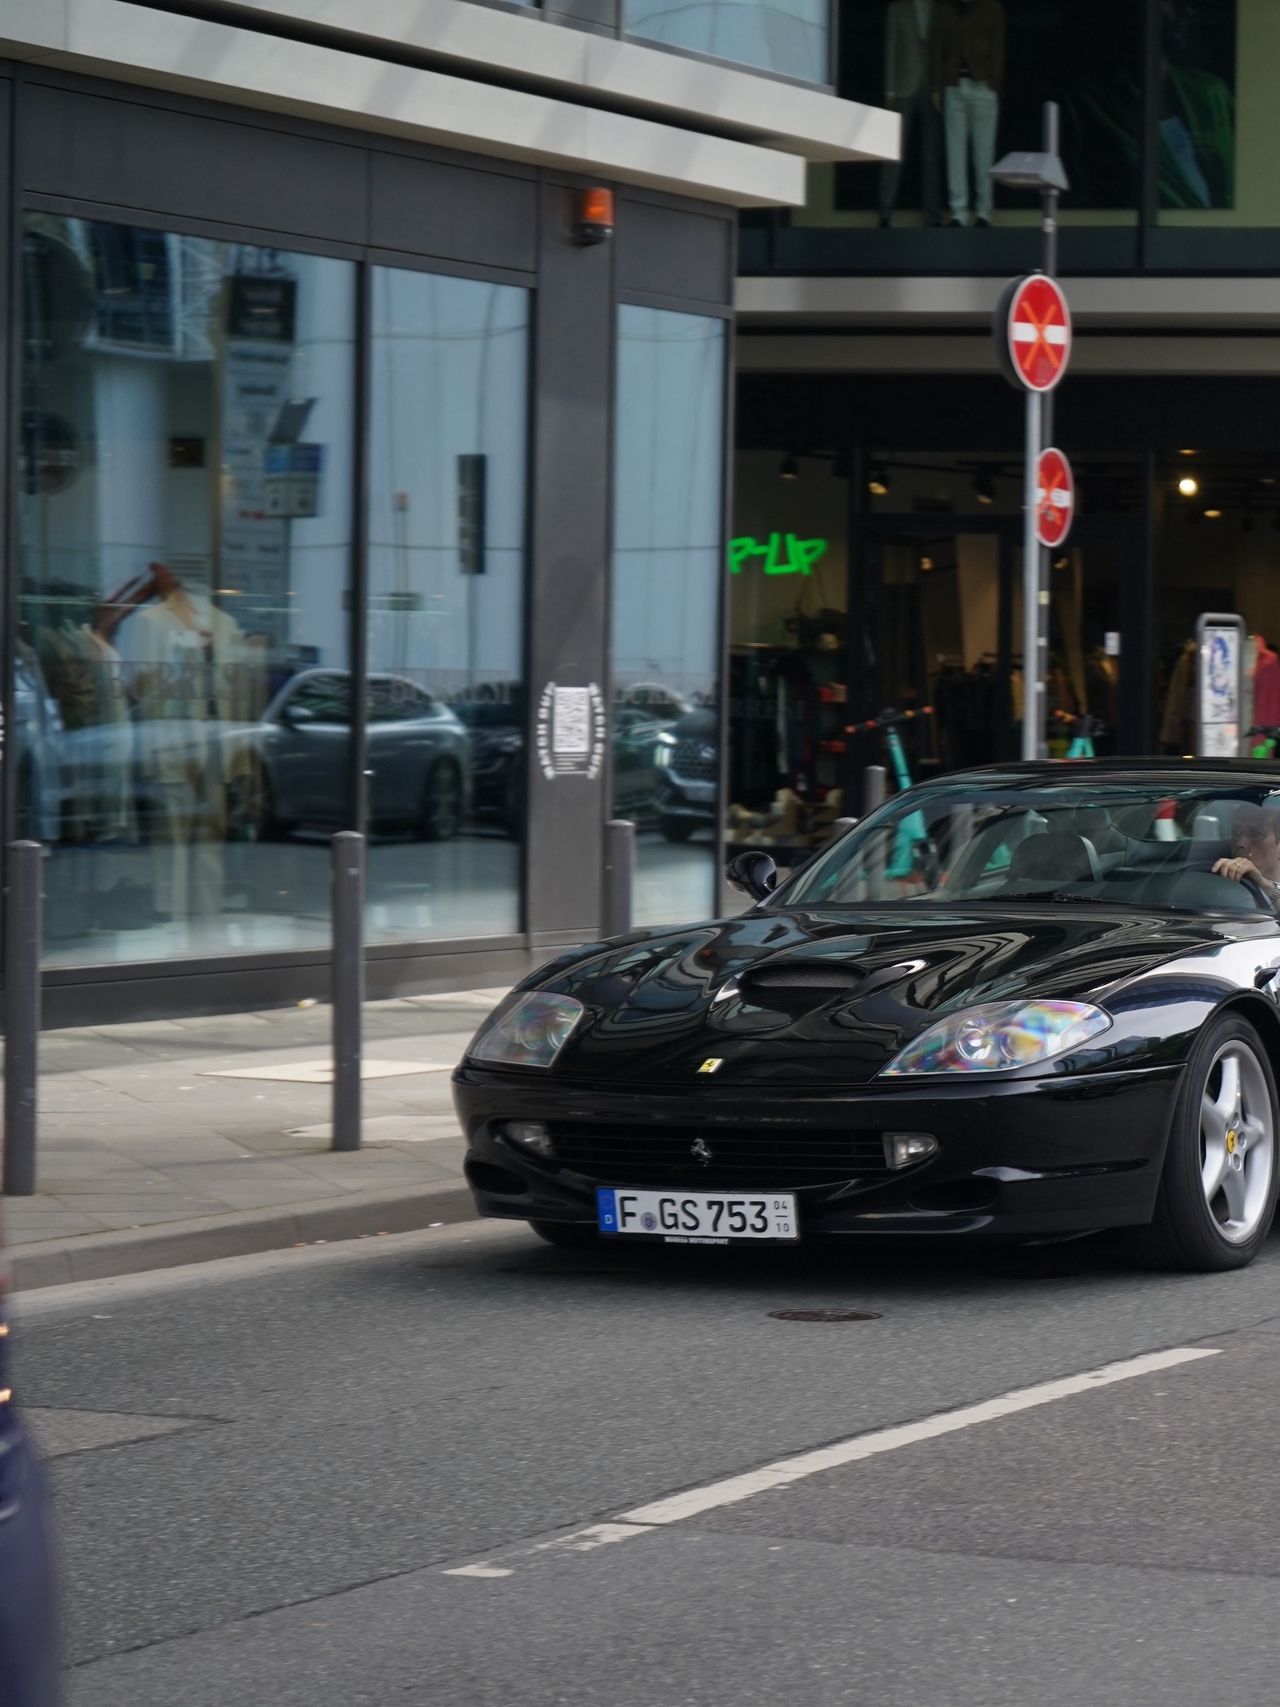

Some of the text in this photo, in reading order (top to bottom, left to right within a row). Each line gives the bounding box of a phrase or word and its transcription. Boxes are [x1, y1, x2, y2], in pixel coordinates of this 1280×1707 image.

[773, 1200, 788, 1210] 04
[604, 1214, 614, 1225] D
[619, 1196, 768, 1233] F GS 753
[776, 1222, 790, 1232] 10
